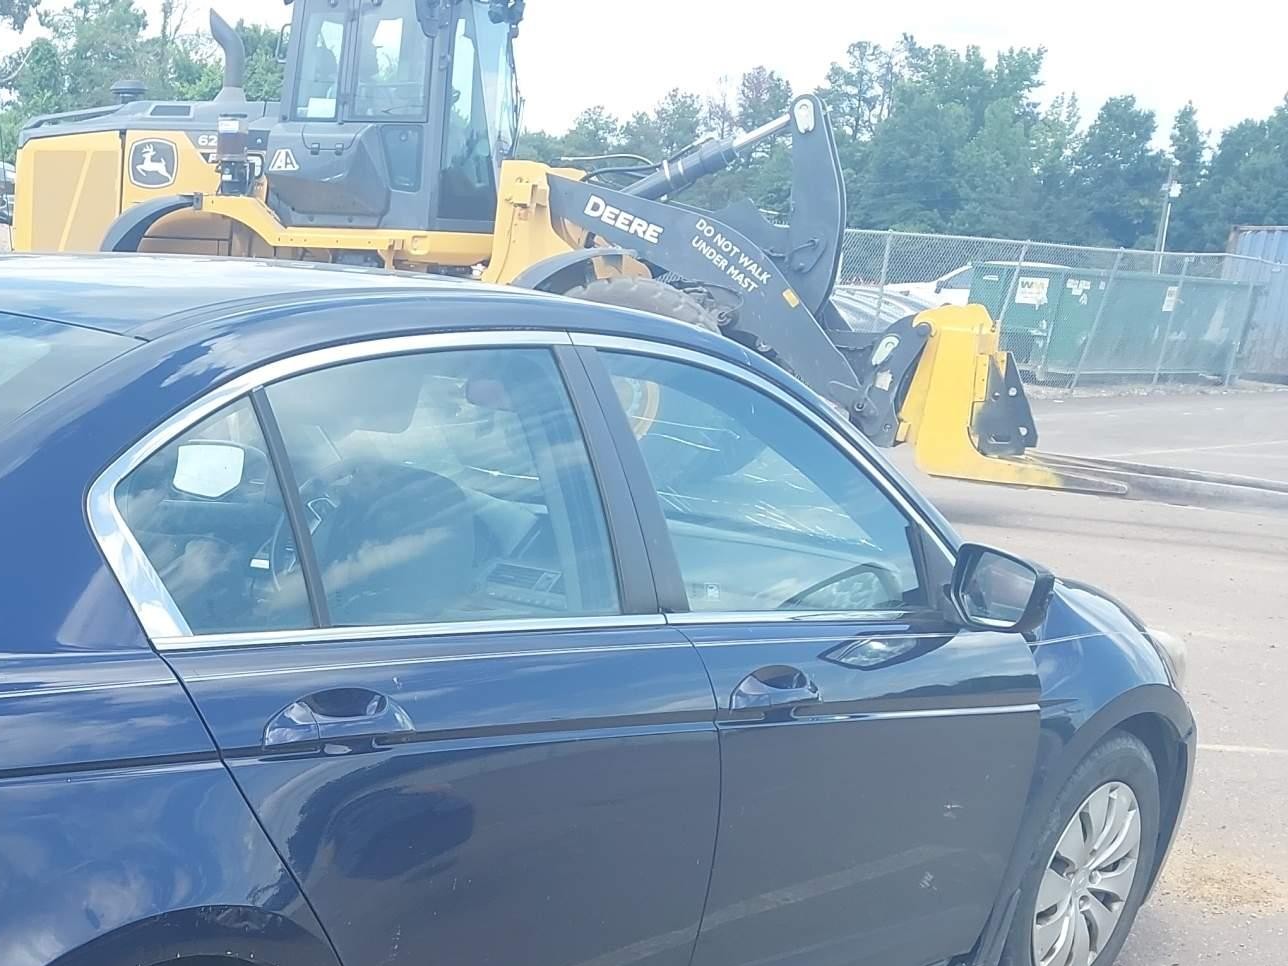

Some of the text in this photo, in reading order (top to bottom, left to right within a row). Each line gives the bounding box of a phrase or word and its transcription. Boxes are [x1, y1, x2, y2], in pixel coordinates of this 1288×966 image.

[198, 134, 217, 146] 62
[583, 194, 664, 244] DEERE
[692, 235, 759, 292] UNDER MAST
[695, 218, 772, 285] DO NOT WALK
